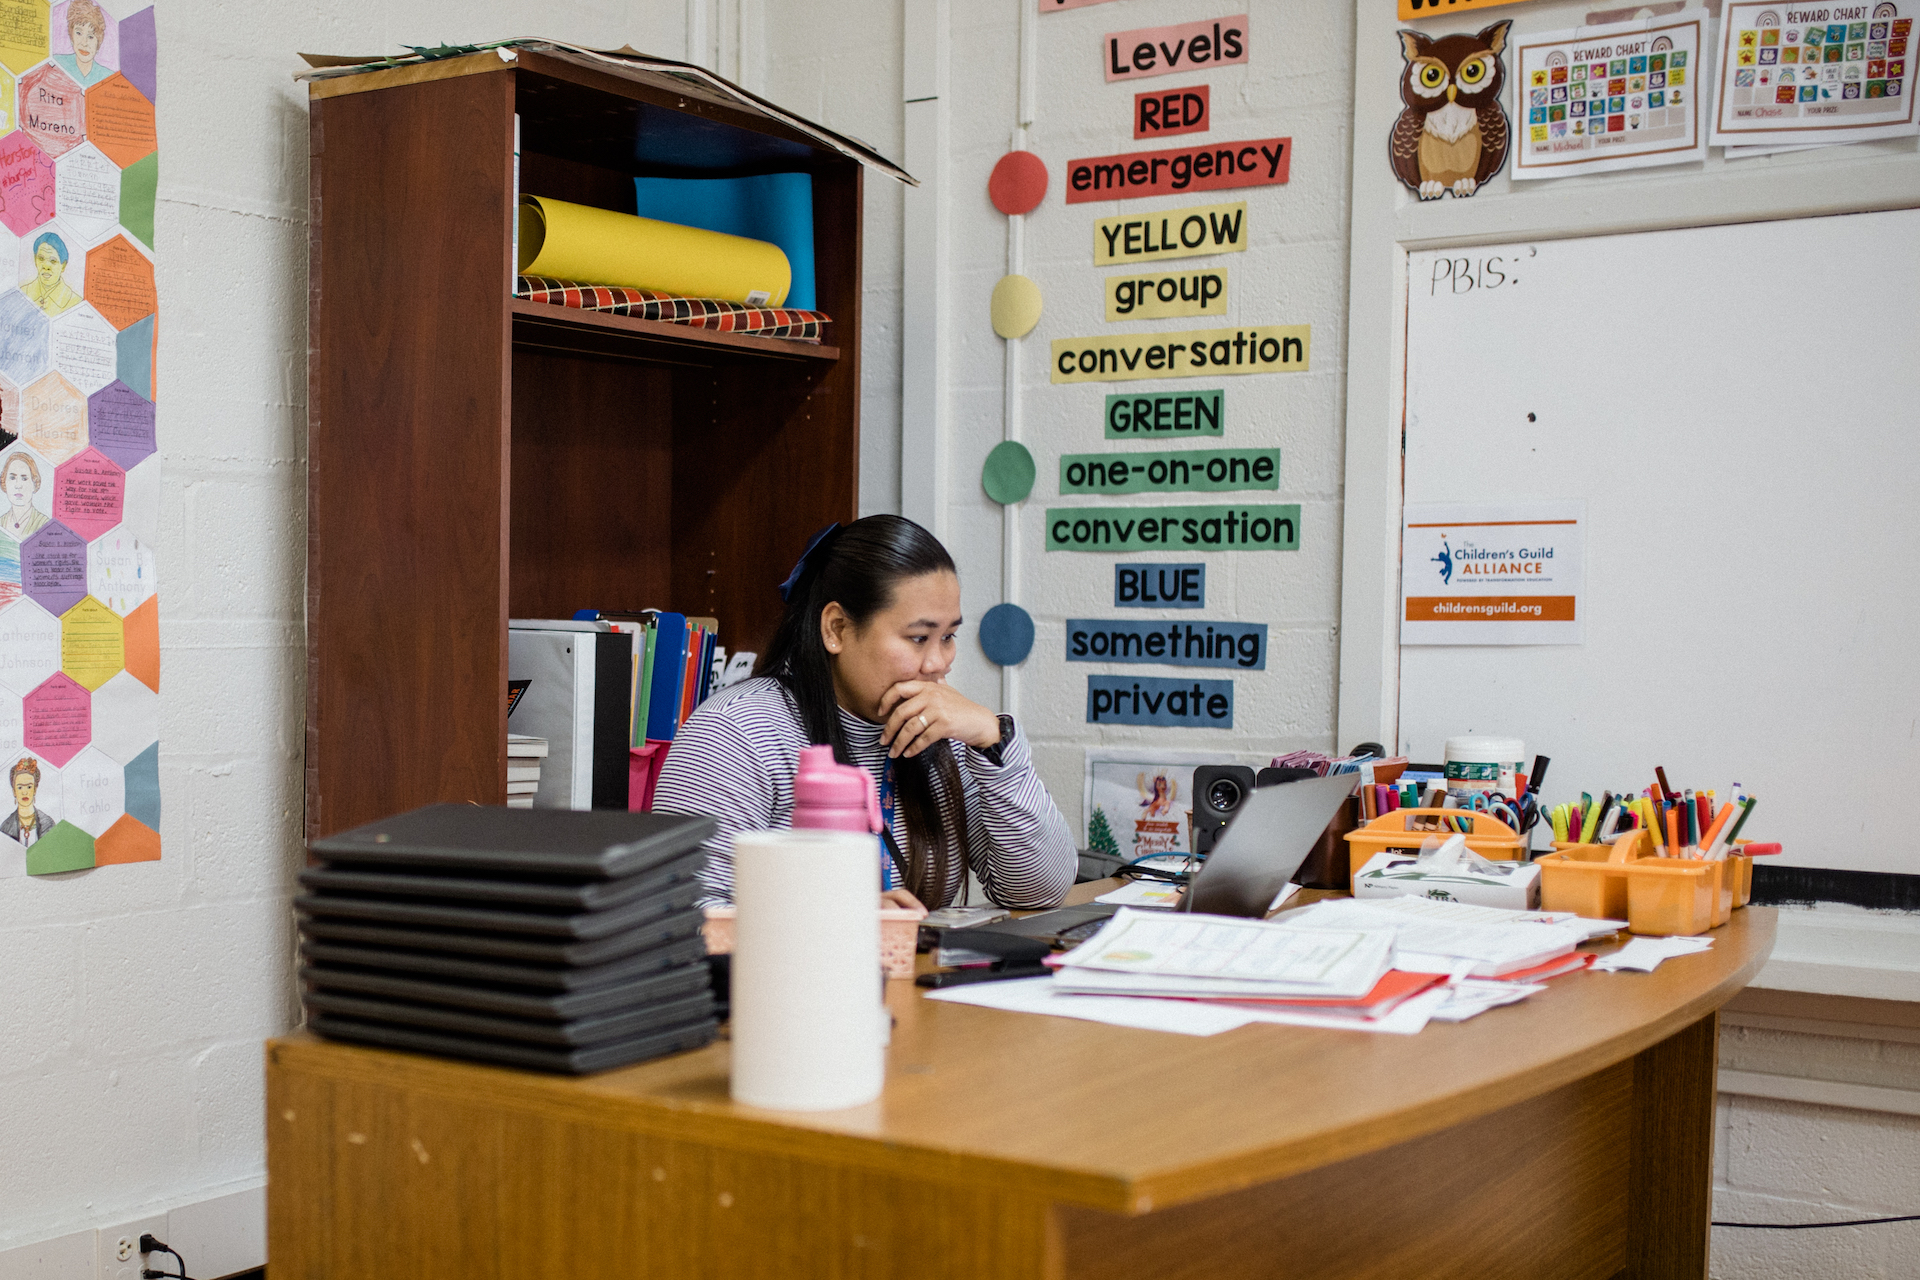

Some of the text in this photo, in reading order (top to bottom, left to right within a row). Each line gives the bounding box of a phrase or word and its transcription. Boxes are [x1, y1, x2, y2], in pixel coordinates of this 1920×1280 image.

[1787, 6, 1868, 24] REWARD CHART
[1110, 22, 1243, 74] Levels
[1573, 41, 1646, 62] REWARD CHART
[39, 87, 64, 106] Rita
[1139, 93, 1205, 133] RED
[1755, 107, 1783, 118] Chase
[1807, 106, 1822, 114] YOUR
[29, 114, 76, 135] Moreno
[1553, 139, 1584, 153] Michael
[1071, 143, 1285, 190] emergency
[1101, 209, 1243, 257] YELLOW
[1431, 256, 1519, 296] PBIS:
[1115, 273, 1223, 313] group
[1058, 331, 1304, 375] conversation
[31, 395, 79, 414] Dolores
[1109, 395, 1220, 433] GREEN
[35, 422, 77, 440] Huerta
[1066, 455, 1274, 487] one-on-one
[1051, 511, 1294, 544] conversation
[1454, 547, 1554, 560] Children's Guild
[1463, 540, 1475, 549] The
[96, 550, 131, 567] Susan
[1462, 562, 1543, 575] ALLIANCE
[98, 577, 146, 597] Anthony
[1118, 568, 1200, 603] BLUE
[1433, 601, 1543, 616] childrensguild.org
[1071, 625, 1260, 667] something
[1092, 683, 1229, 721] private
[80, 773, 109, 789] Frida
[80, 799, 111, 815] Kahlo
